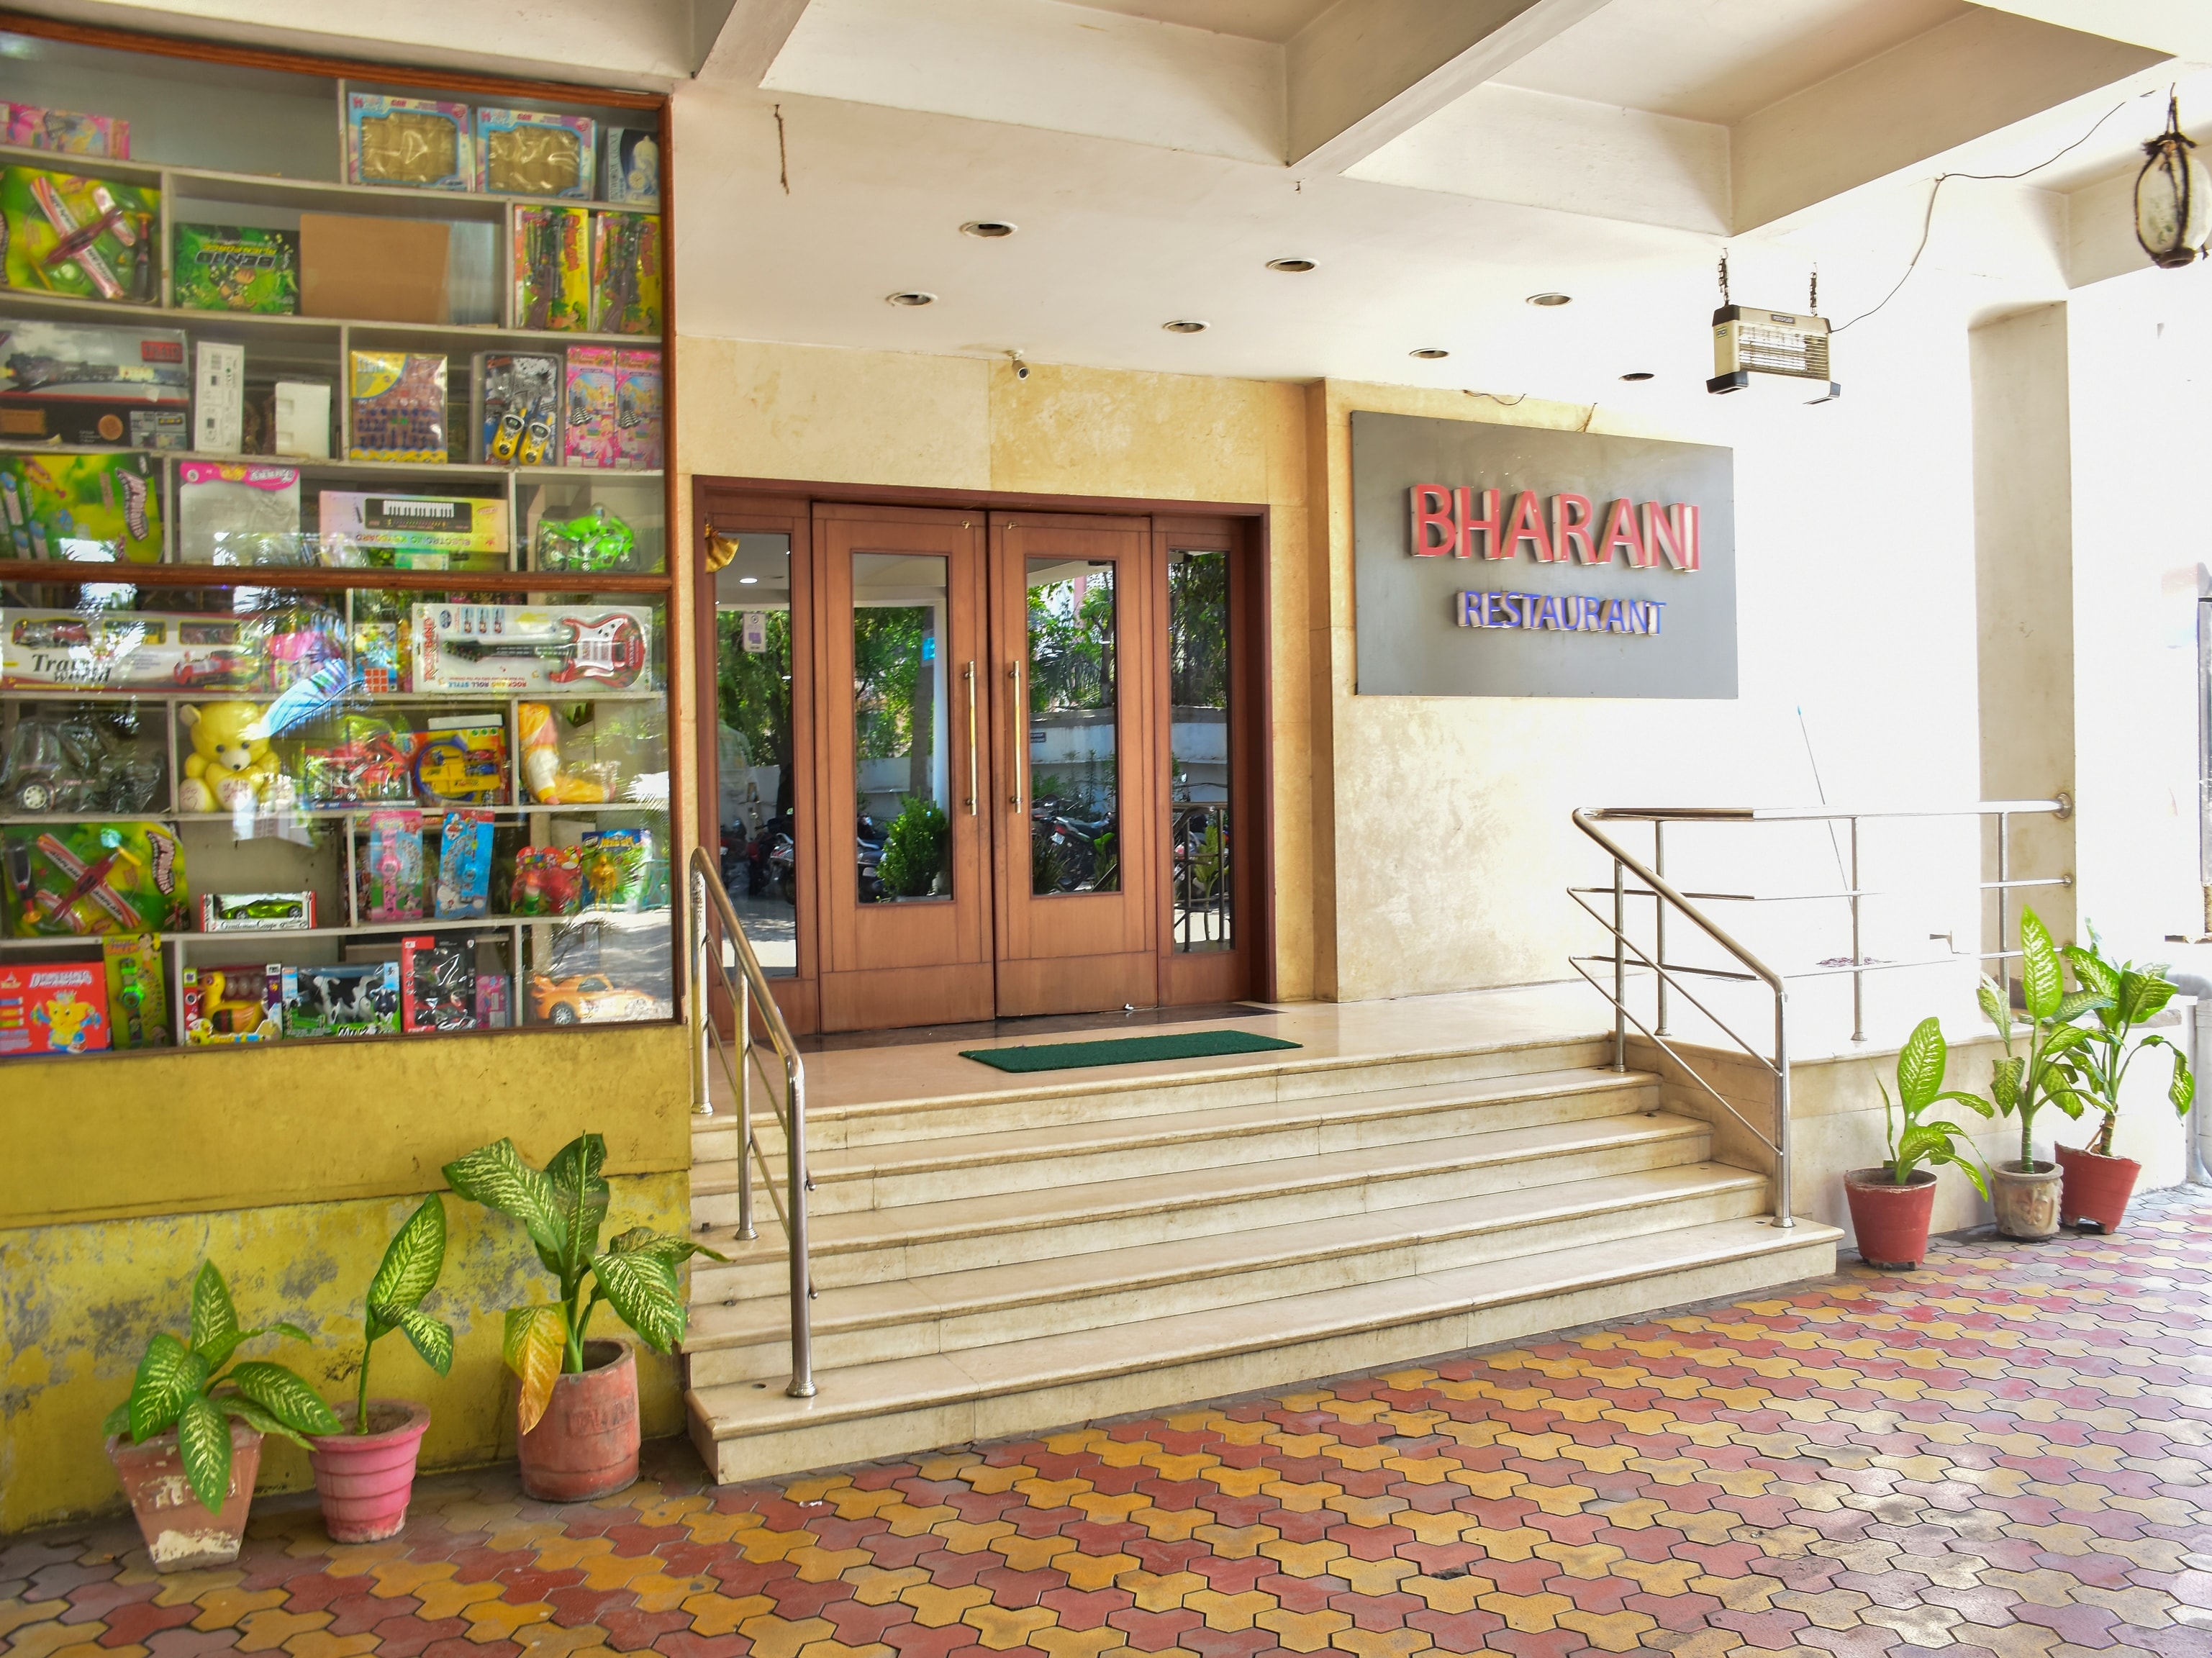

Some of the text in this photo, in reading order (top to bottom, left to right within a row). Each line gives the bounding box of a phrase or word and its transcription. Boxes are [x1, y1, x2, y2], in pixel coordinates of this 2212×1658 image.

[355, 533, 407, 544] KEYBOARD
[1410, 483, 1700, 573] BHARANI
[1456, 589, 1667, 636] RESTAURANT
